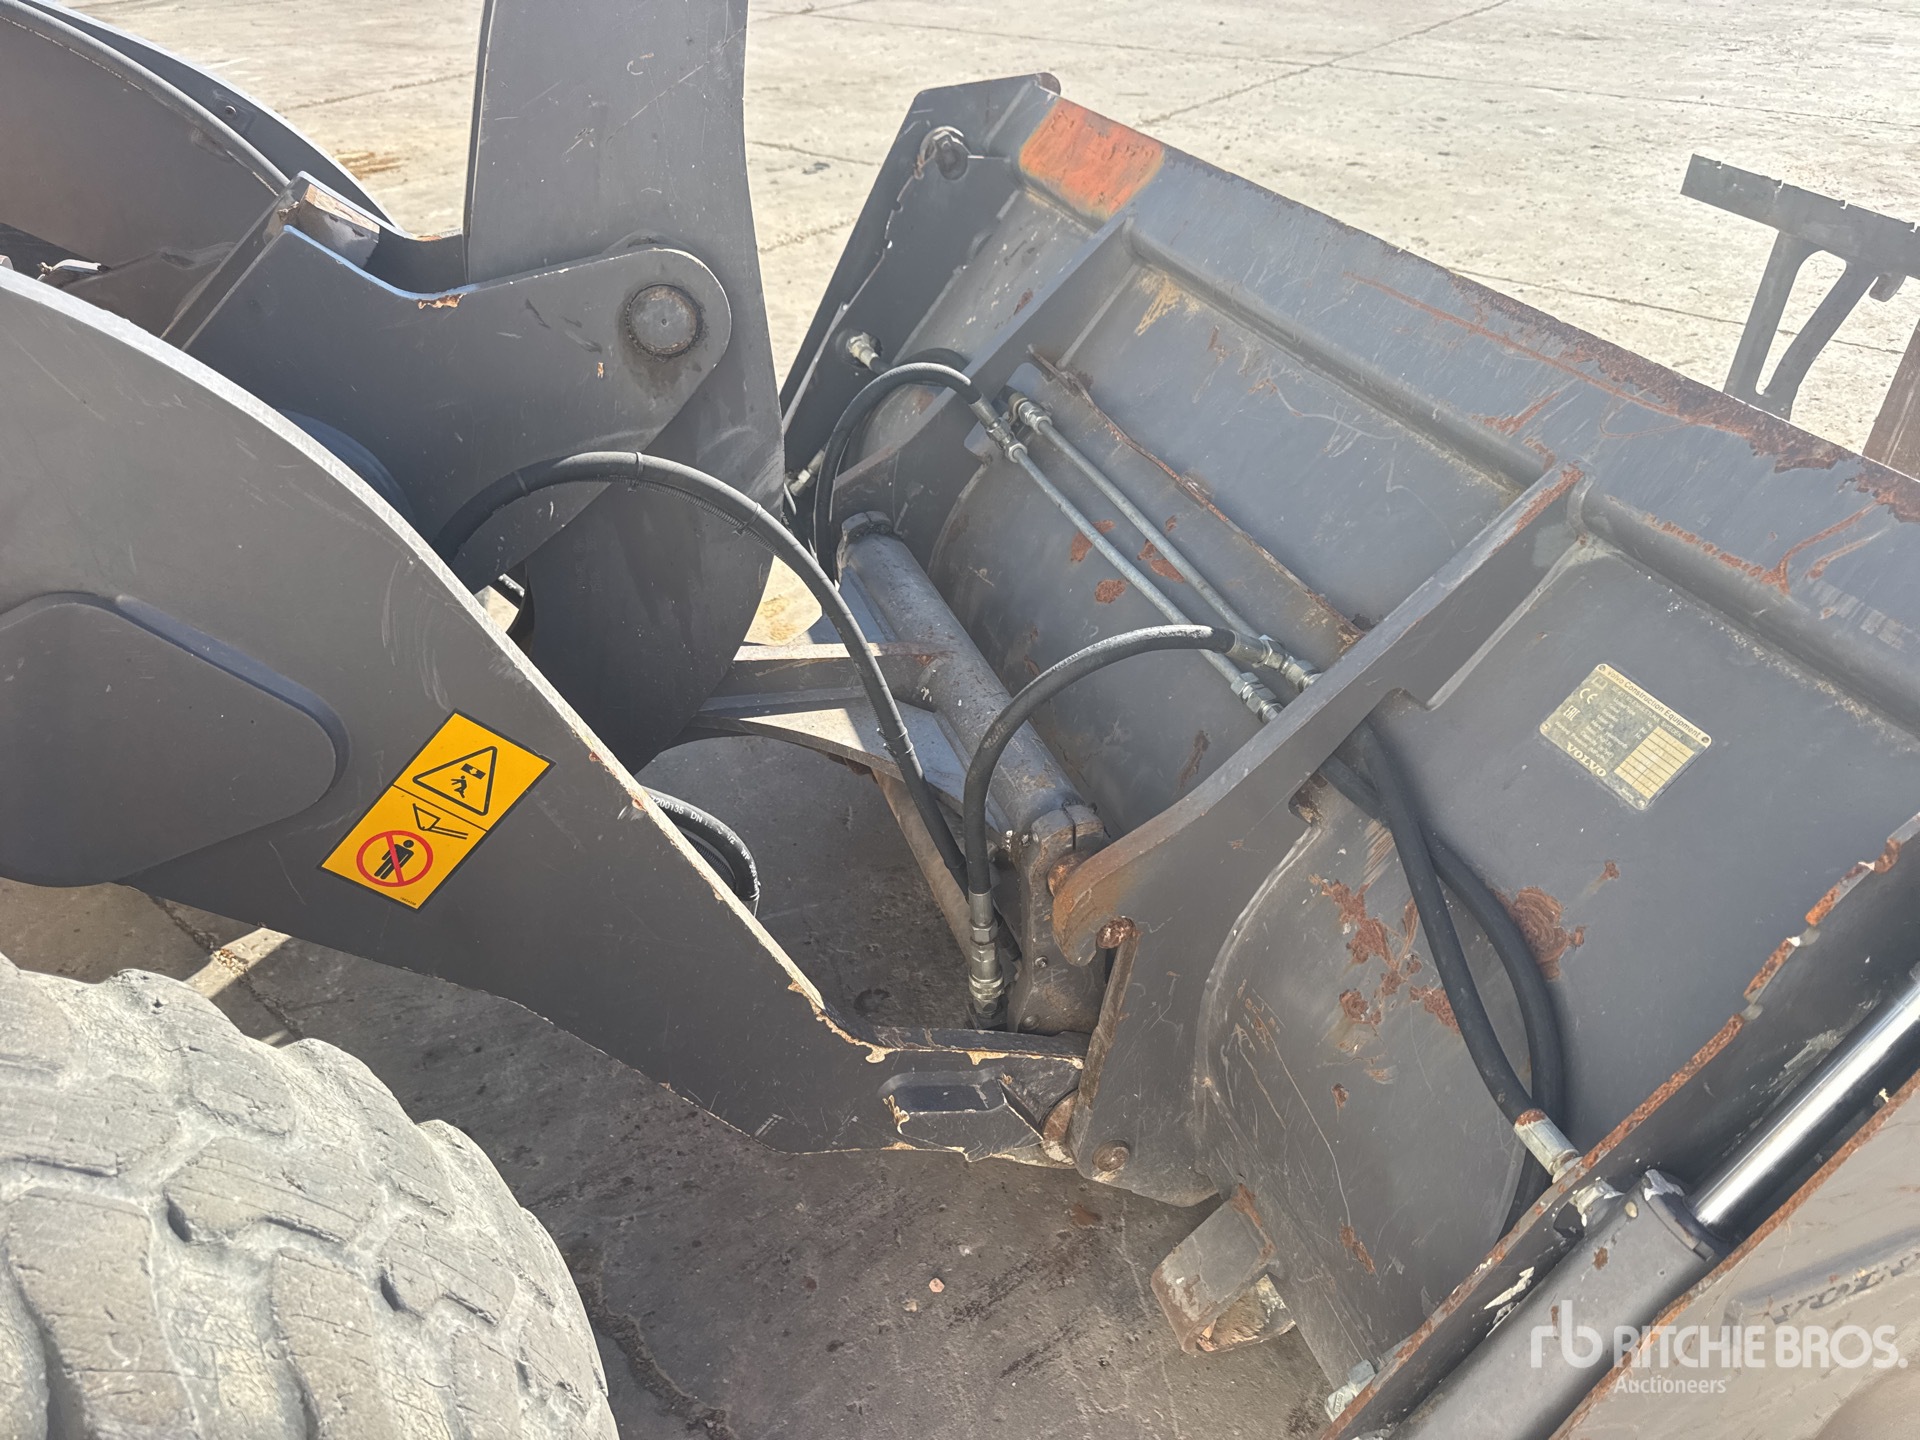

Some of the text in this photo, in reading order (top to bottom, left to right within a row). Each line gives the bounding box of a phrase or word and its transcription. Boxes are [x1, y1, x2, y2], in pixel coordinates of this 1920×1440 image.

[1607, 671, 1701, 738] Volvo Construction Equipment
[1565, 742, 1607, 777] VOLVO
[690, 812, 703, 822] DN
